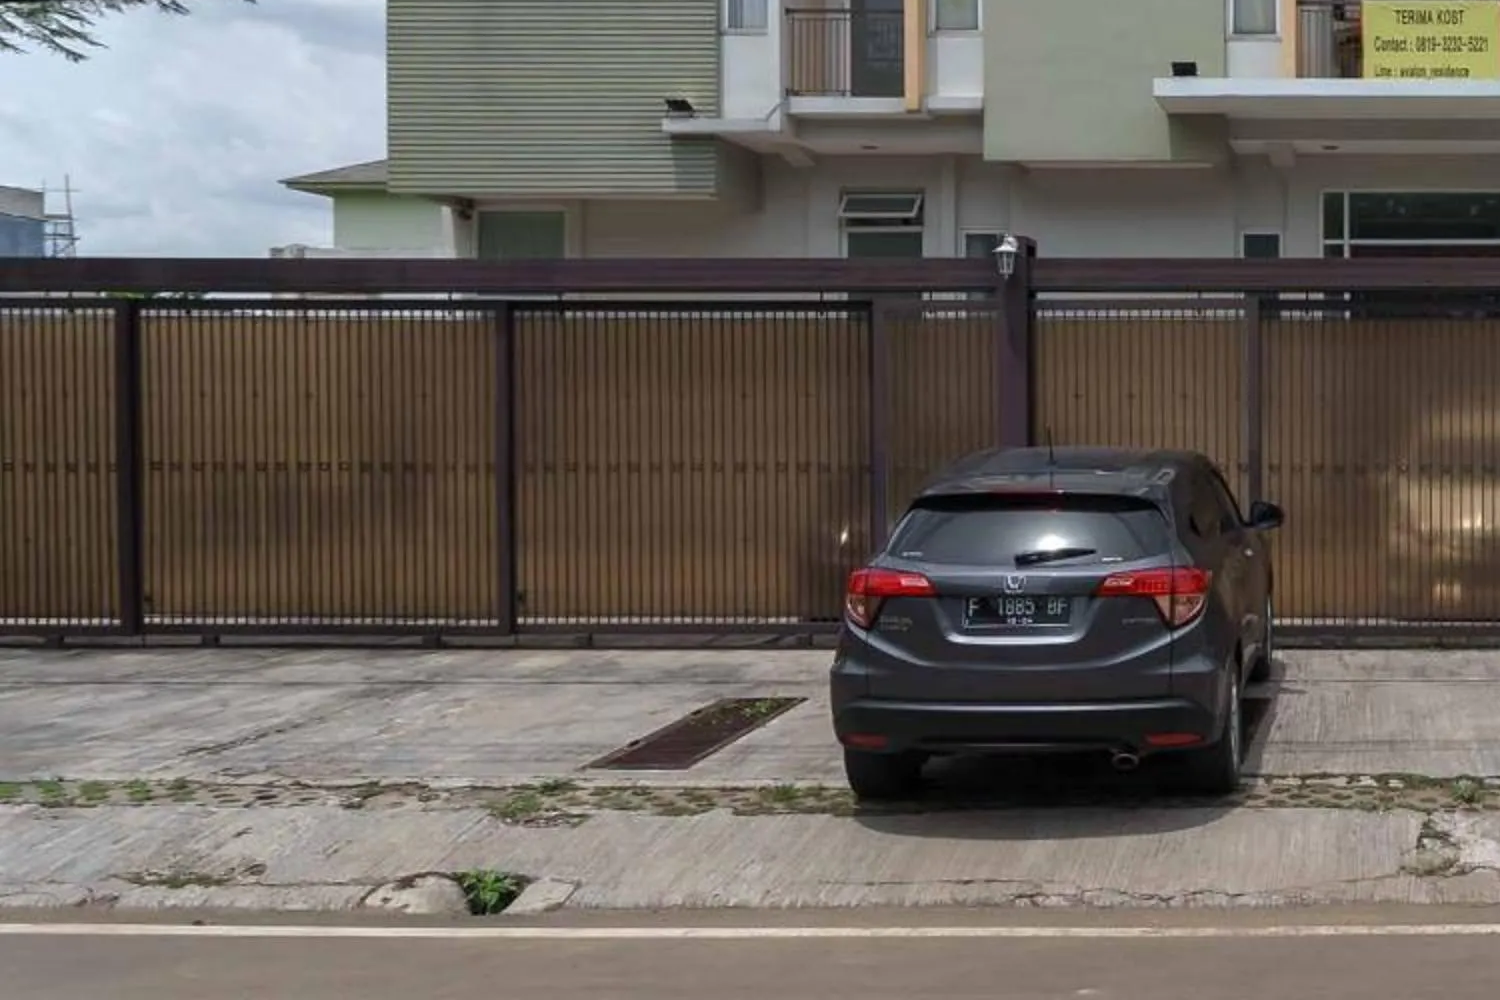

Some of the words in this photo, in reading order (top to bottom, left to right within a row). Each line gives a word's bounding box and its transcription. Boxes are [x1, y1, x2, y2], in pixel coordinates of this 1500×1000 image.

[1393, 9, 1435, 25] TERIMA
[1437, 9, 1465, 25] KOST
[1374, 35, 1408, 52] Contact
[968, 598, 979, 617] F
